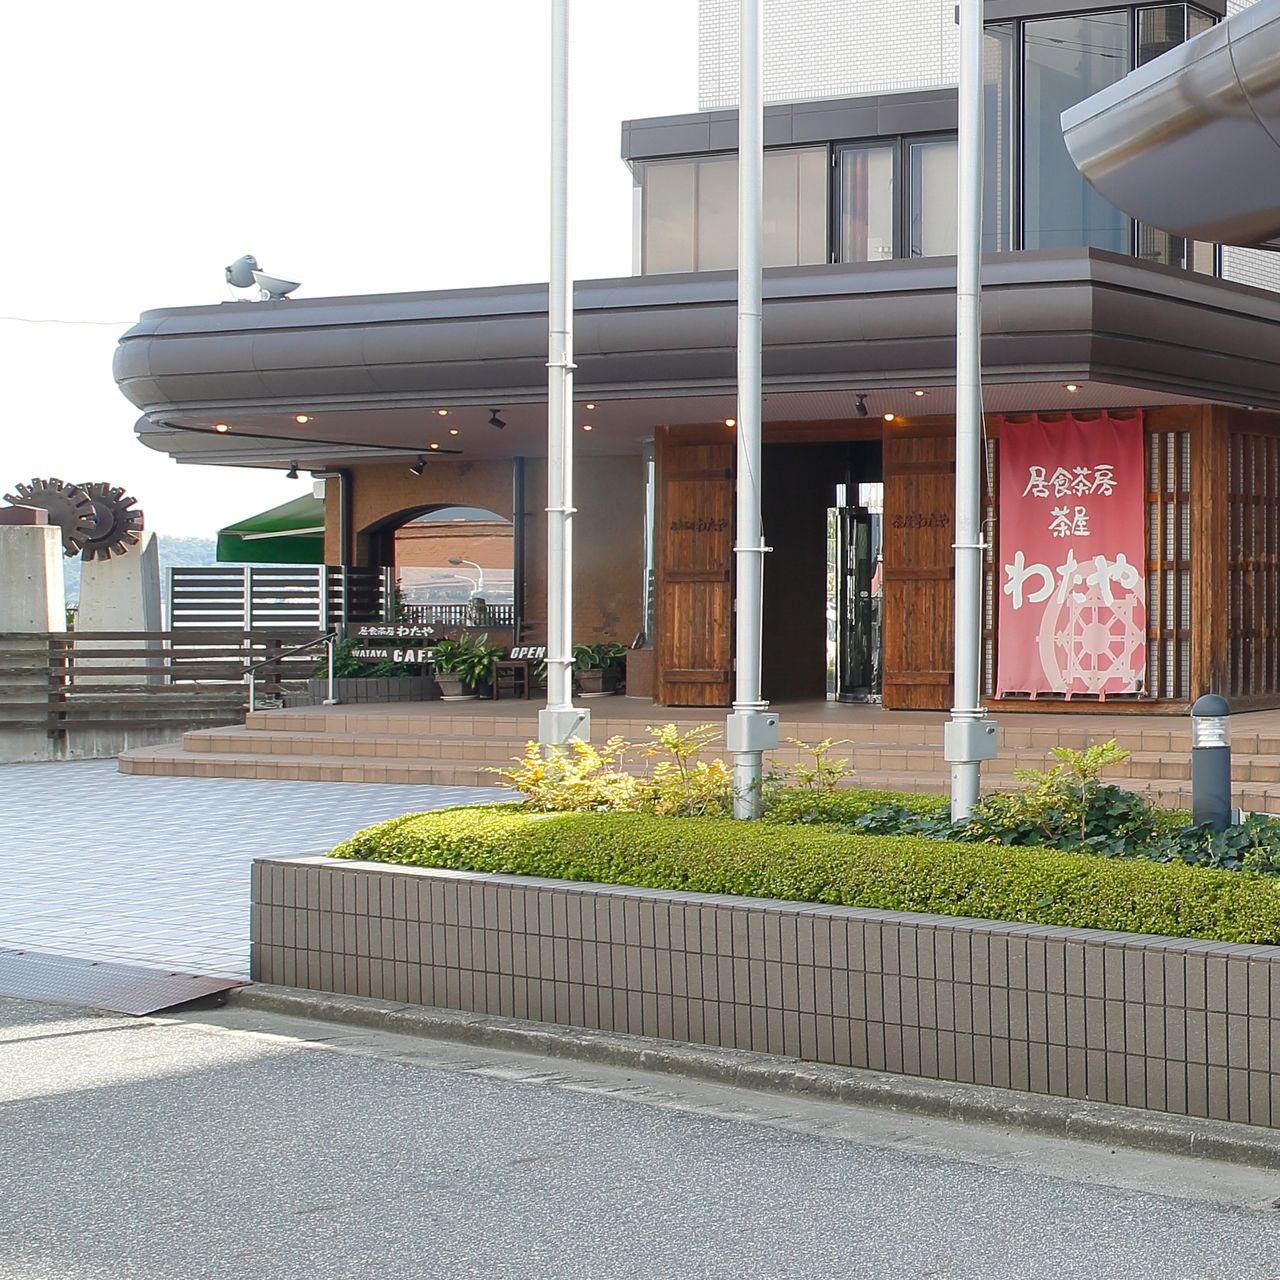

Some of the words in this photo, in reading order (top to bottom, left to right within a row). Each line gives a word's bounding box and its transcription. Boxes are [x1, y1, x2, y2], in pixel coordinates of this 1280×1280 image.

[1022, 464, 1118, 498] 居食茶房
[1048, 506, 1091, 538] 茶屋
[1003, 548, 1139, 610] わたや
[351, 649, 388, 658] WATAYA
[510, 646, 546, 659] OPEN
